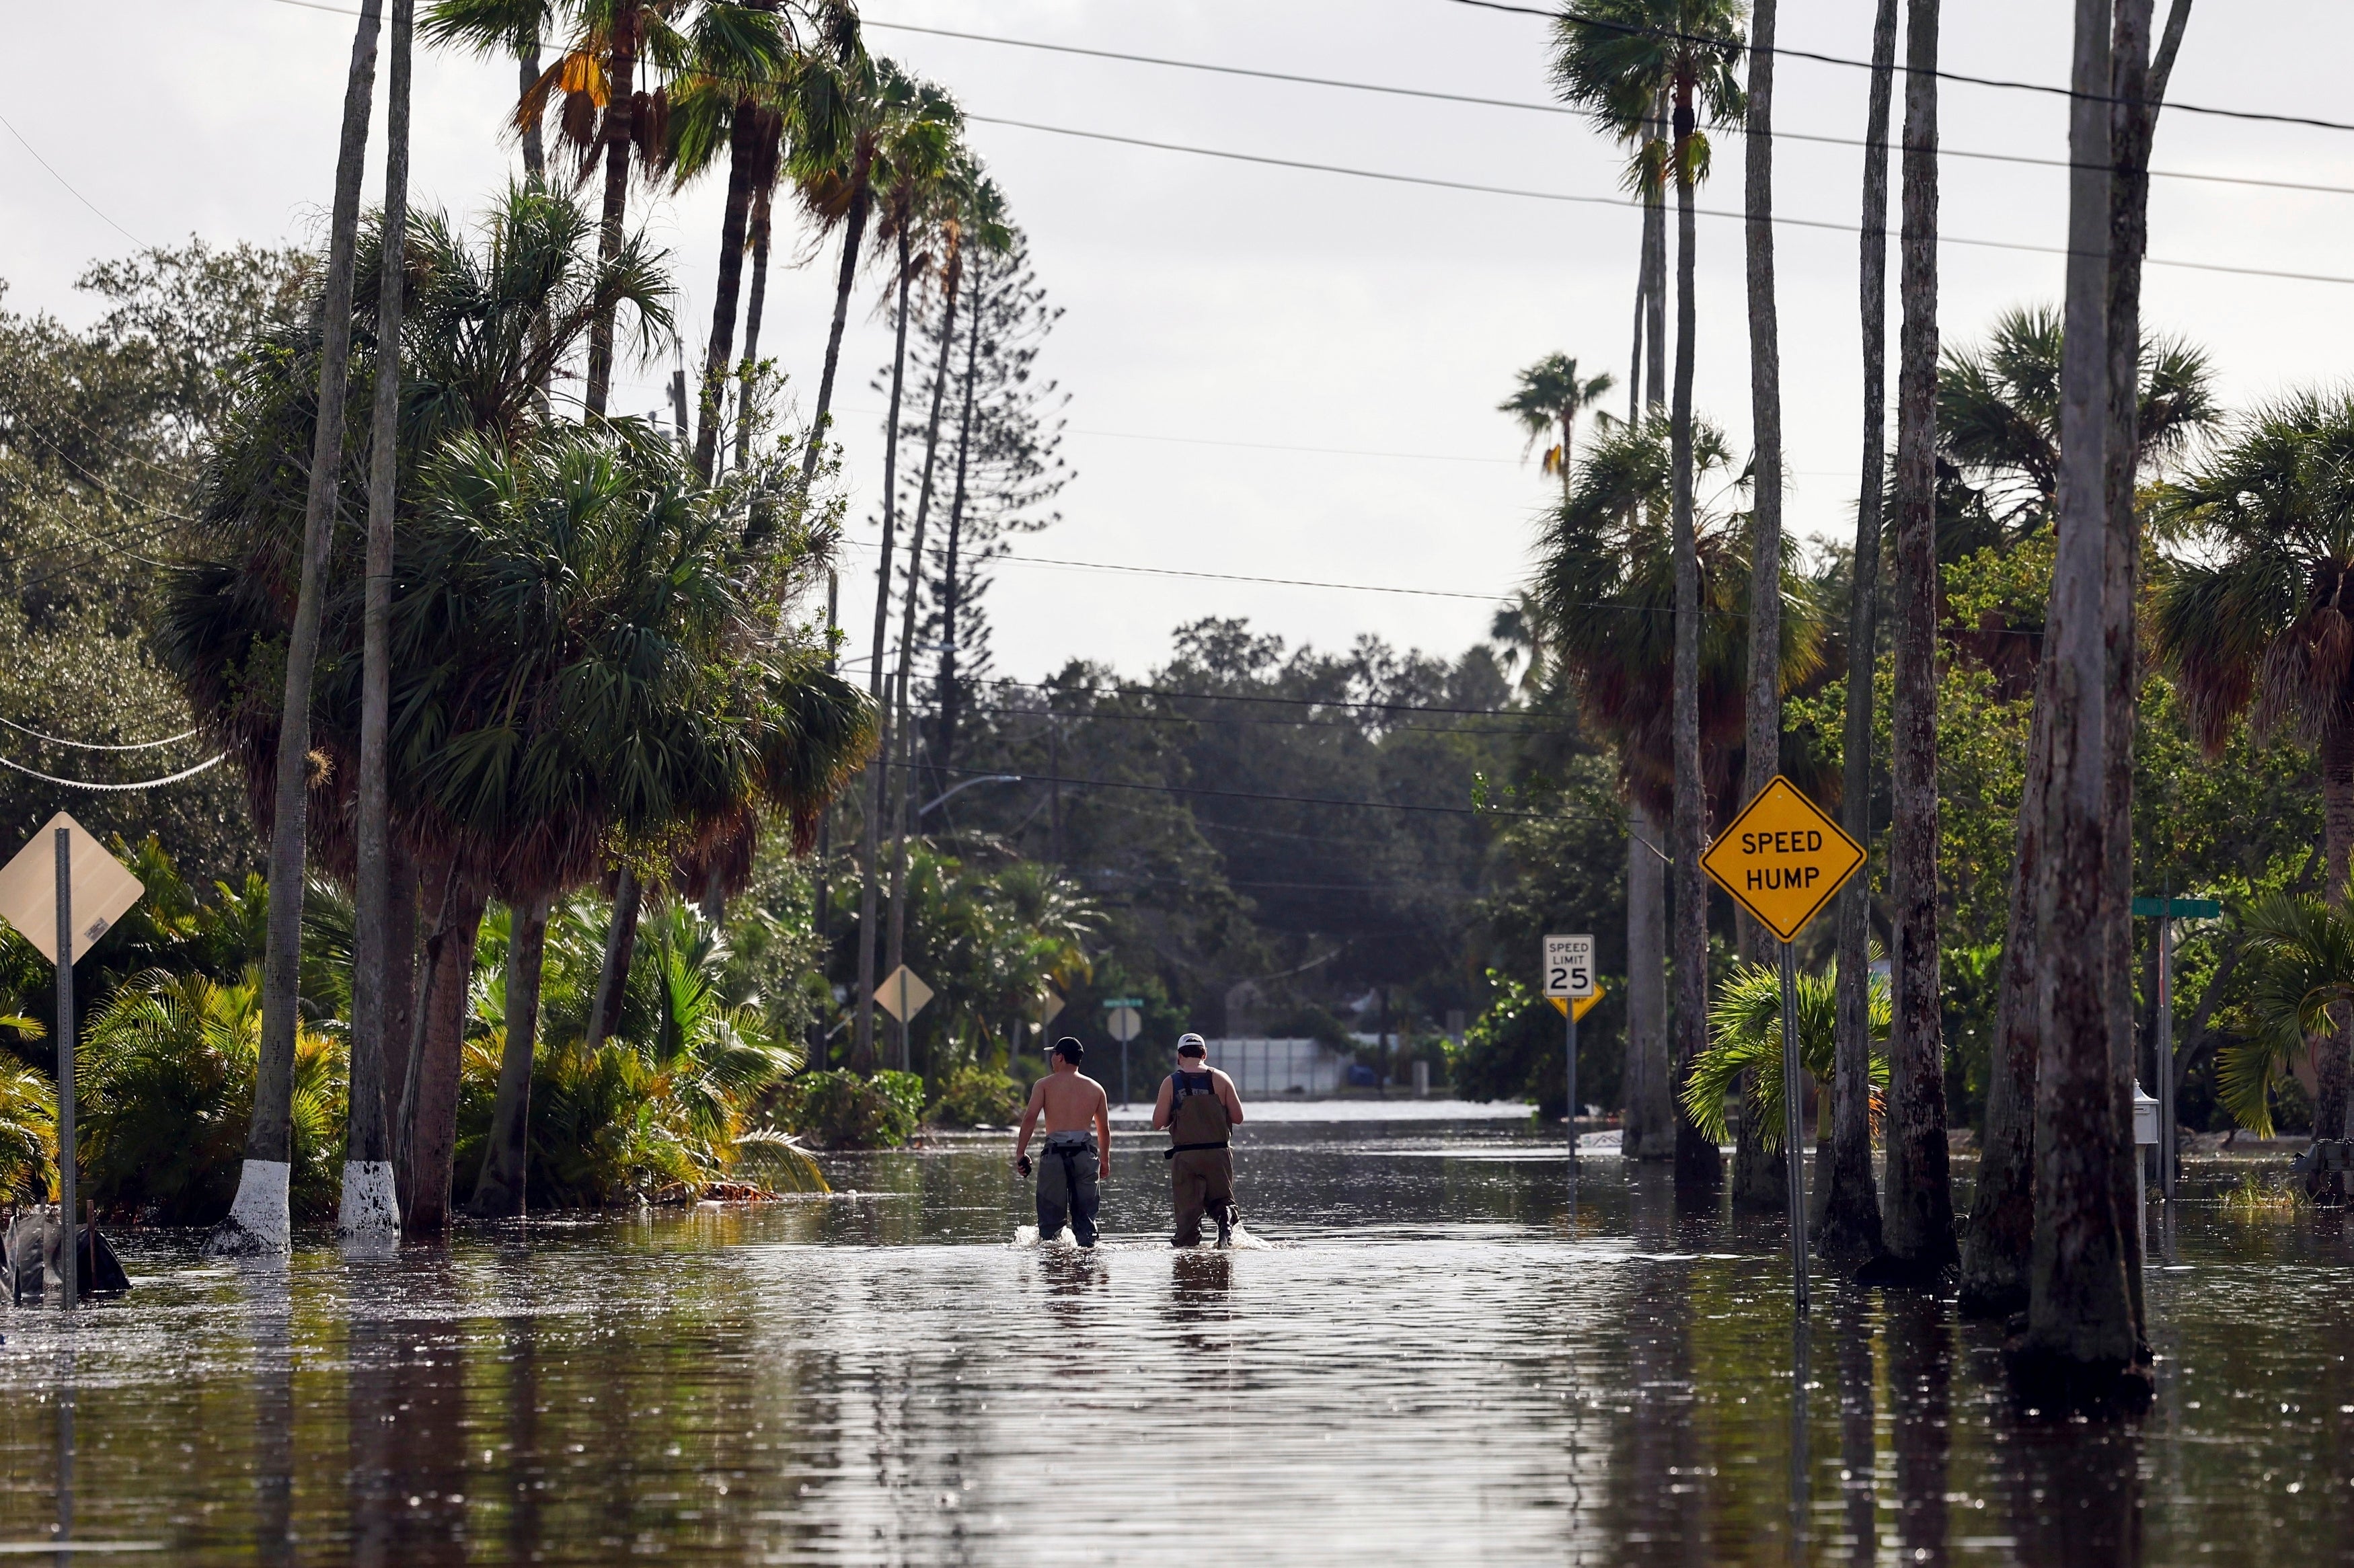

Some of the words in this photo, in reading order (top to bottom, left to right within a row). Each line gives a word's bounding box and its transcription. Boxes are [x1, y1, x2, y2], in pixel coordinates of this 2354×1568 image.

[1742, 830, 1822, 854] SPEED
[1747, 867, 1820, 890] HUMP
[1549, 943, 1589, 953] SPEED
[1553, 955, 1584, 965] LIMIT
[1550, 968, 1588, 989] 25
